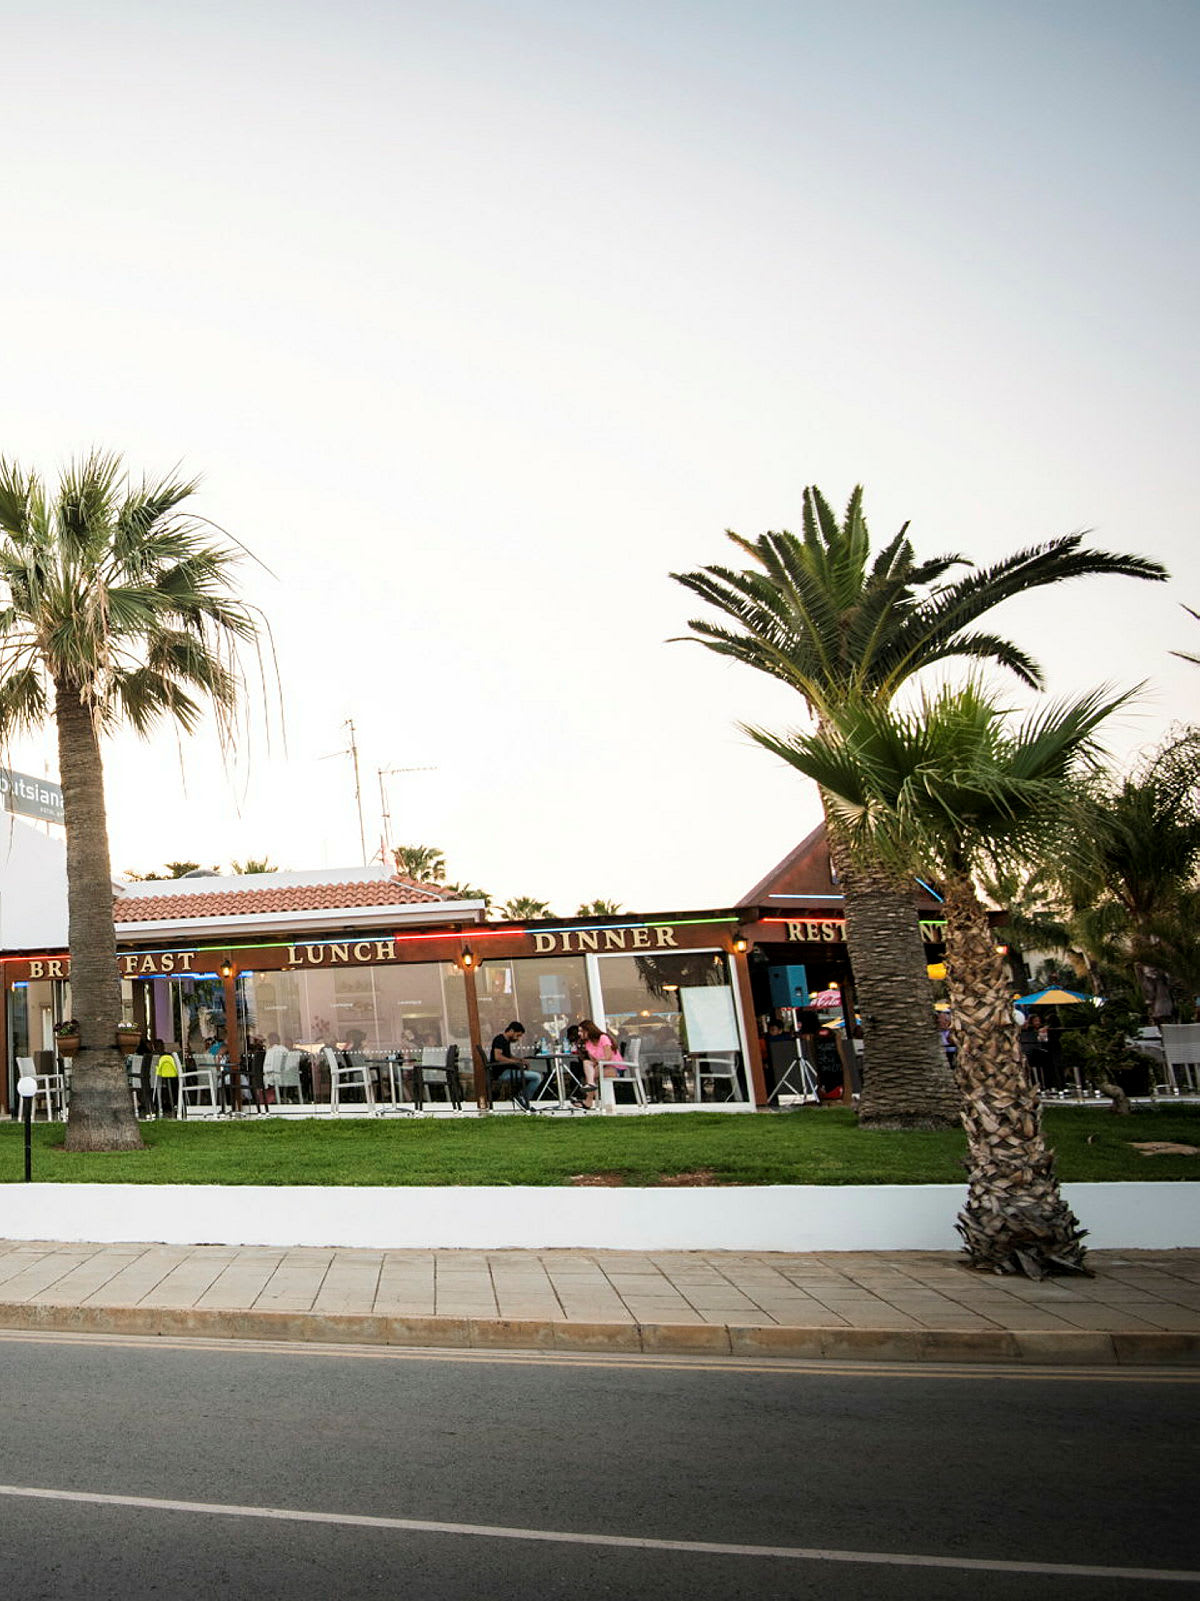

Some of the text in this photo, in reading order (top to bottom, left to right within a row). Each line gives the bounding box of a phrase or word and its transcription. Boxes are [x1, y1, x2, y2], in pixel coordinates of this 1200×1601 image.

[287, 941, 398, 965] LUNCH
[534, 926, 679, 953] DINNER
[29, 952, 195, 979] BRFAST
